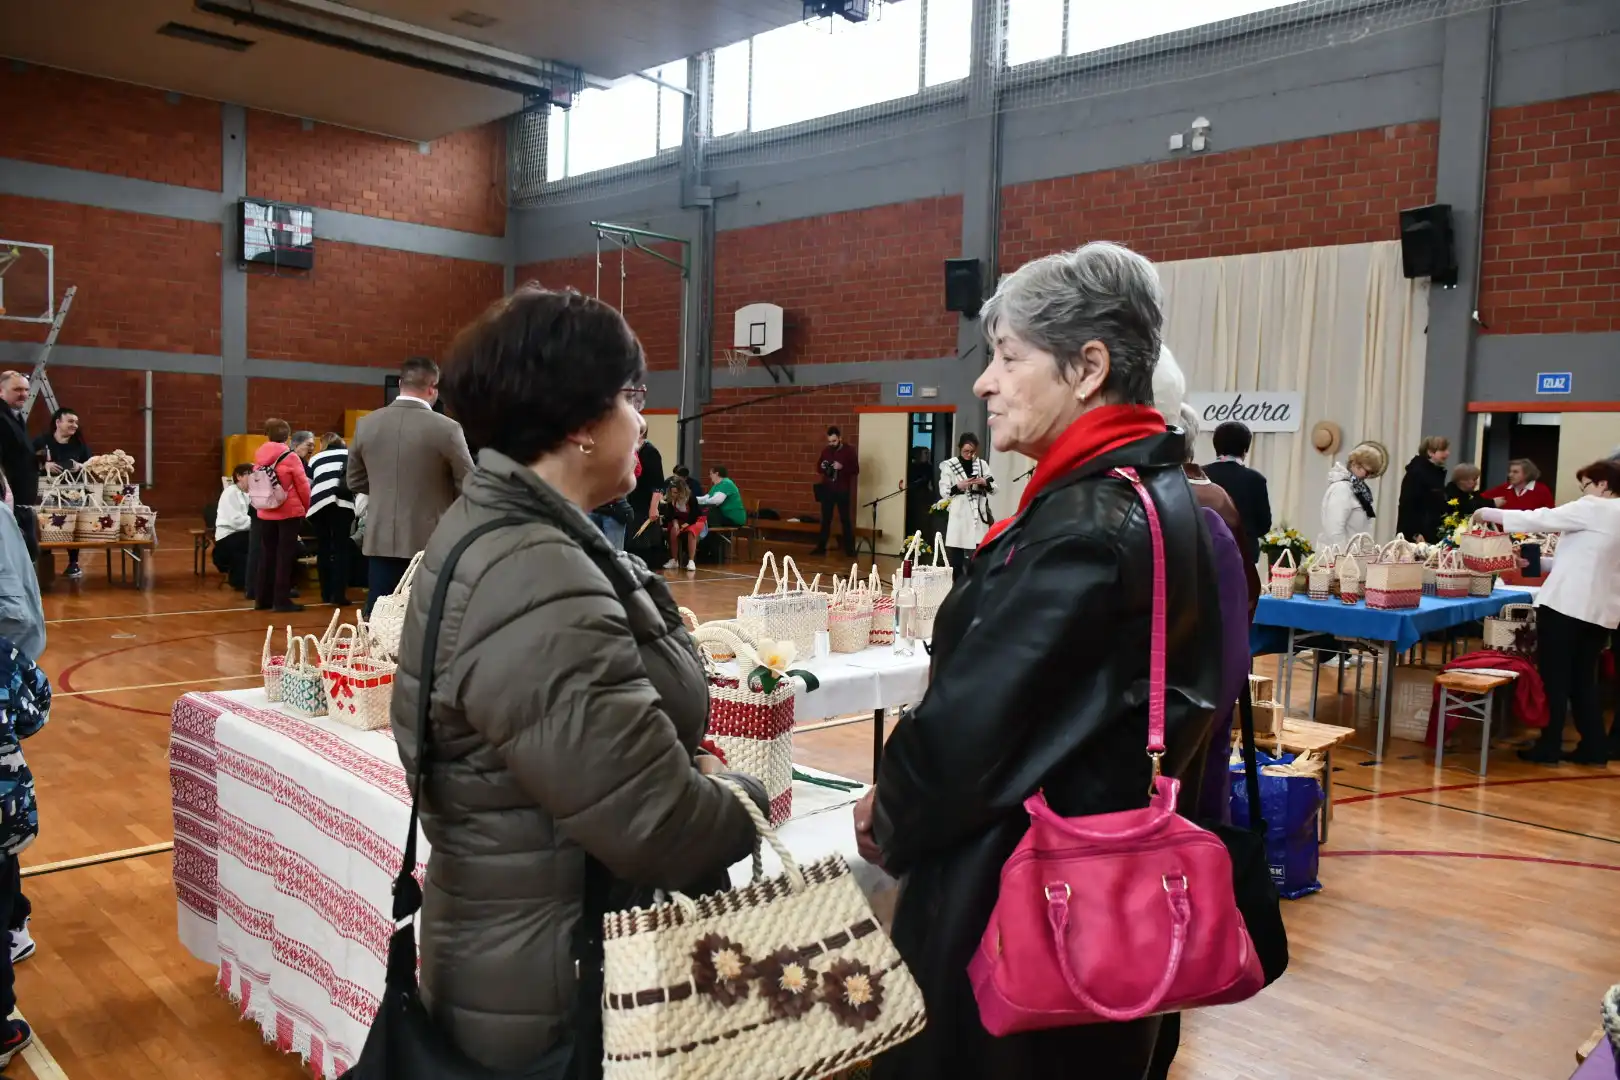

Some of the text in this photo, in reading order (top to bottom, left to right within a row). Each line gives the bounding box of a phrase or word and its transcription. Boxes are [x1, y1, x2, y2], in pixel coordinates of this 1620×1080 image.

[1543, 377, 1565, 388] IZLAZ
[1203, 393, 1291, 421] cekara
[1269, 867, 1282, 875] SK
